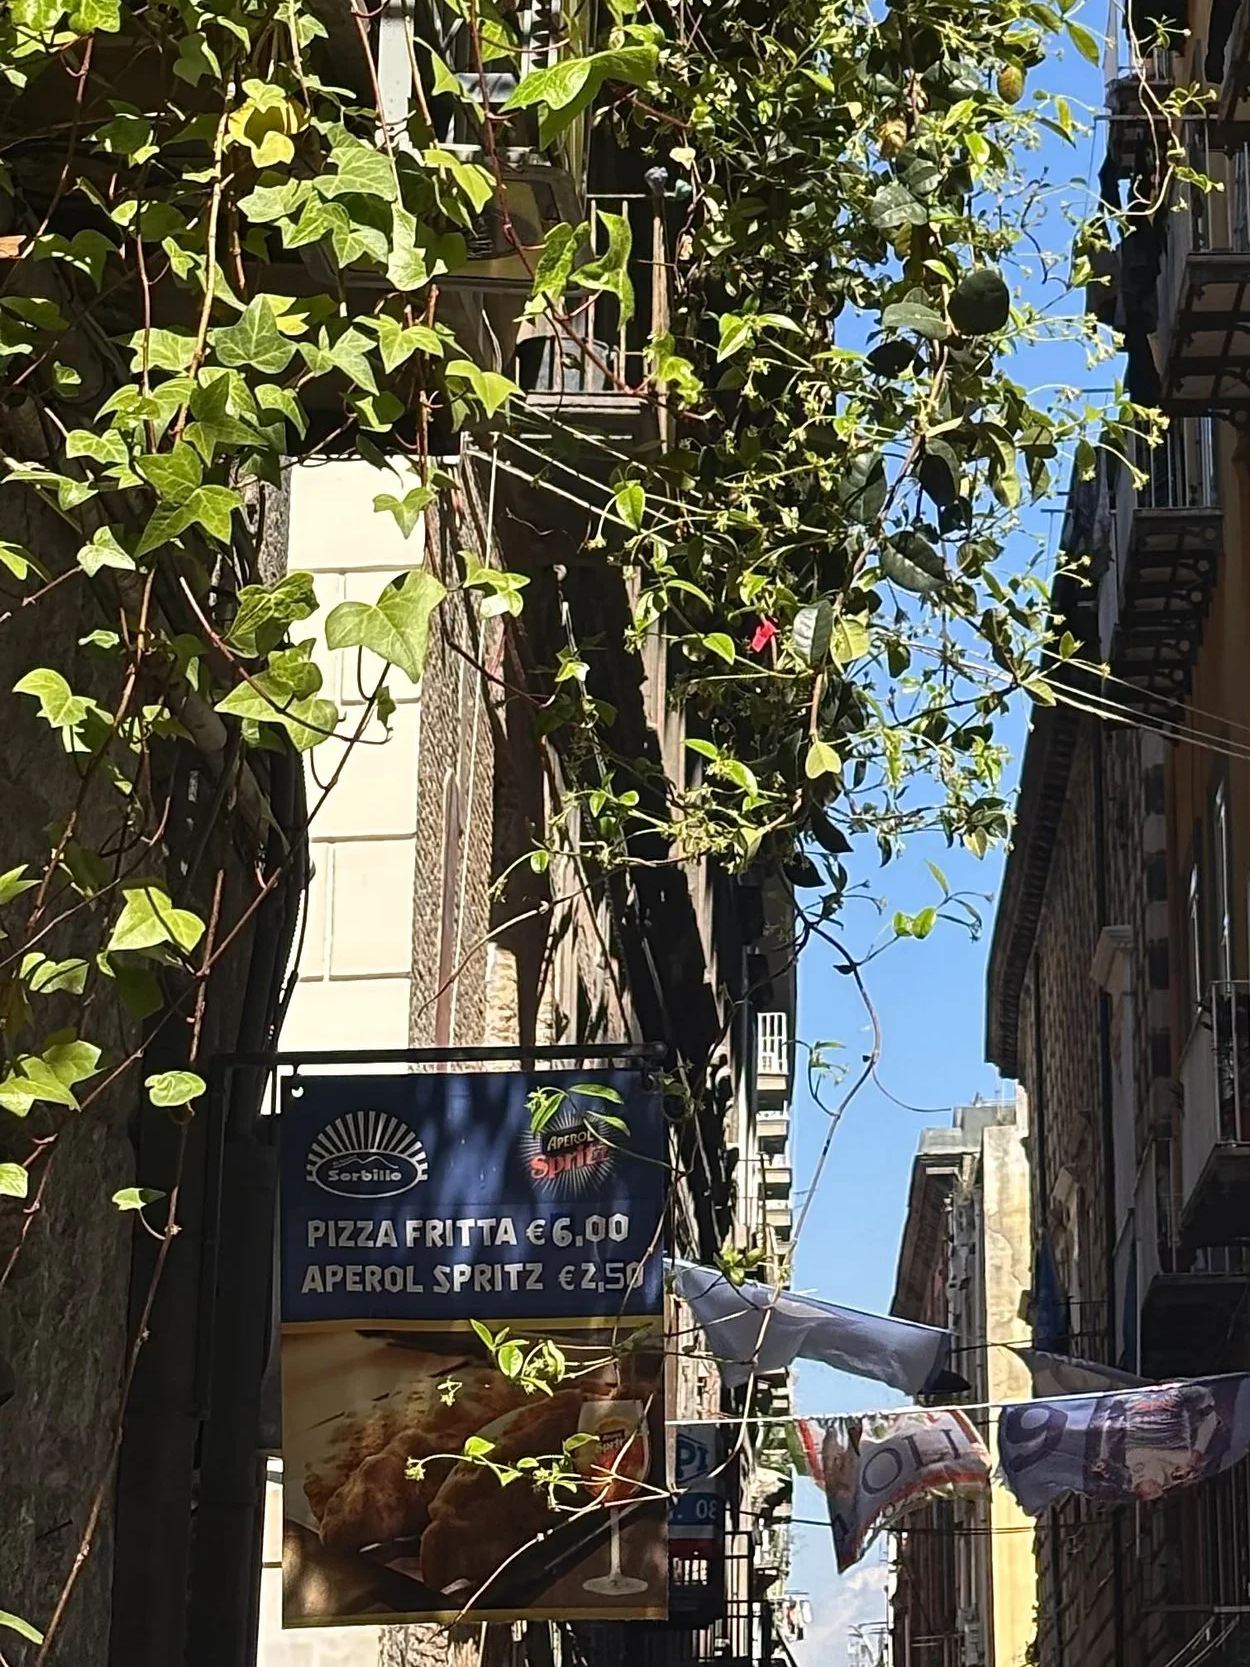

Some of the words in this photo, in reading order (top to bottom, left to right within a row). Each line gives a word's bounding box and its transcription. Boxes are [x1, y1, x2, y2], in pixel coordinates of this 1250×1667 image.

[546, 1130, 595, 1152] APEROL
[327, 1168, 402, 1182] Sorbillo
[307, 1218, 398, 1248] PIZZA
[405, 1217, 518, 1248] FRITTA
[301, 1263, 424, 1294] APEROL
[432, 1262, 545, 1295] SPRITZ
